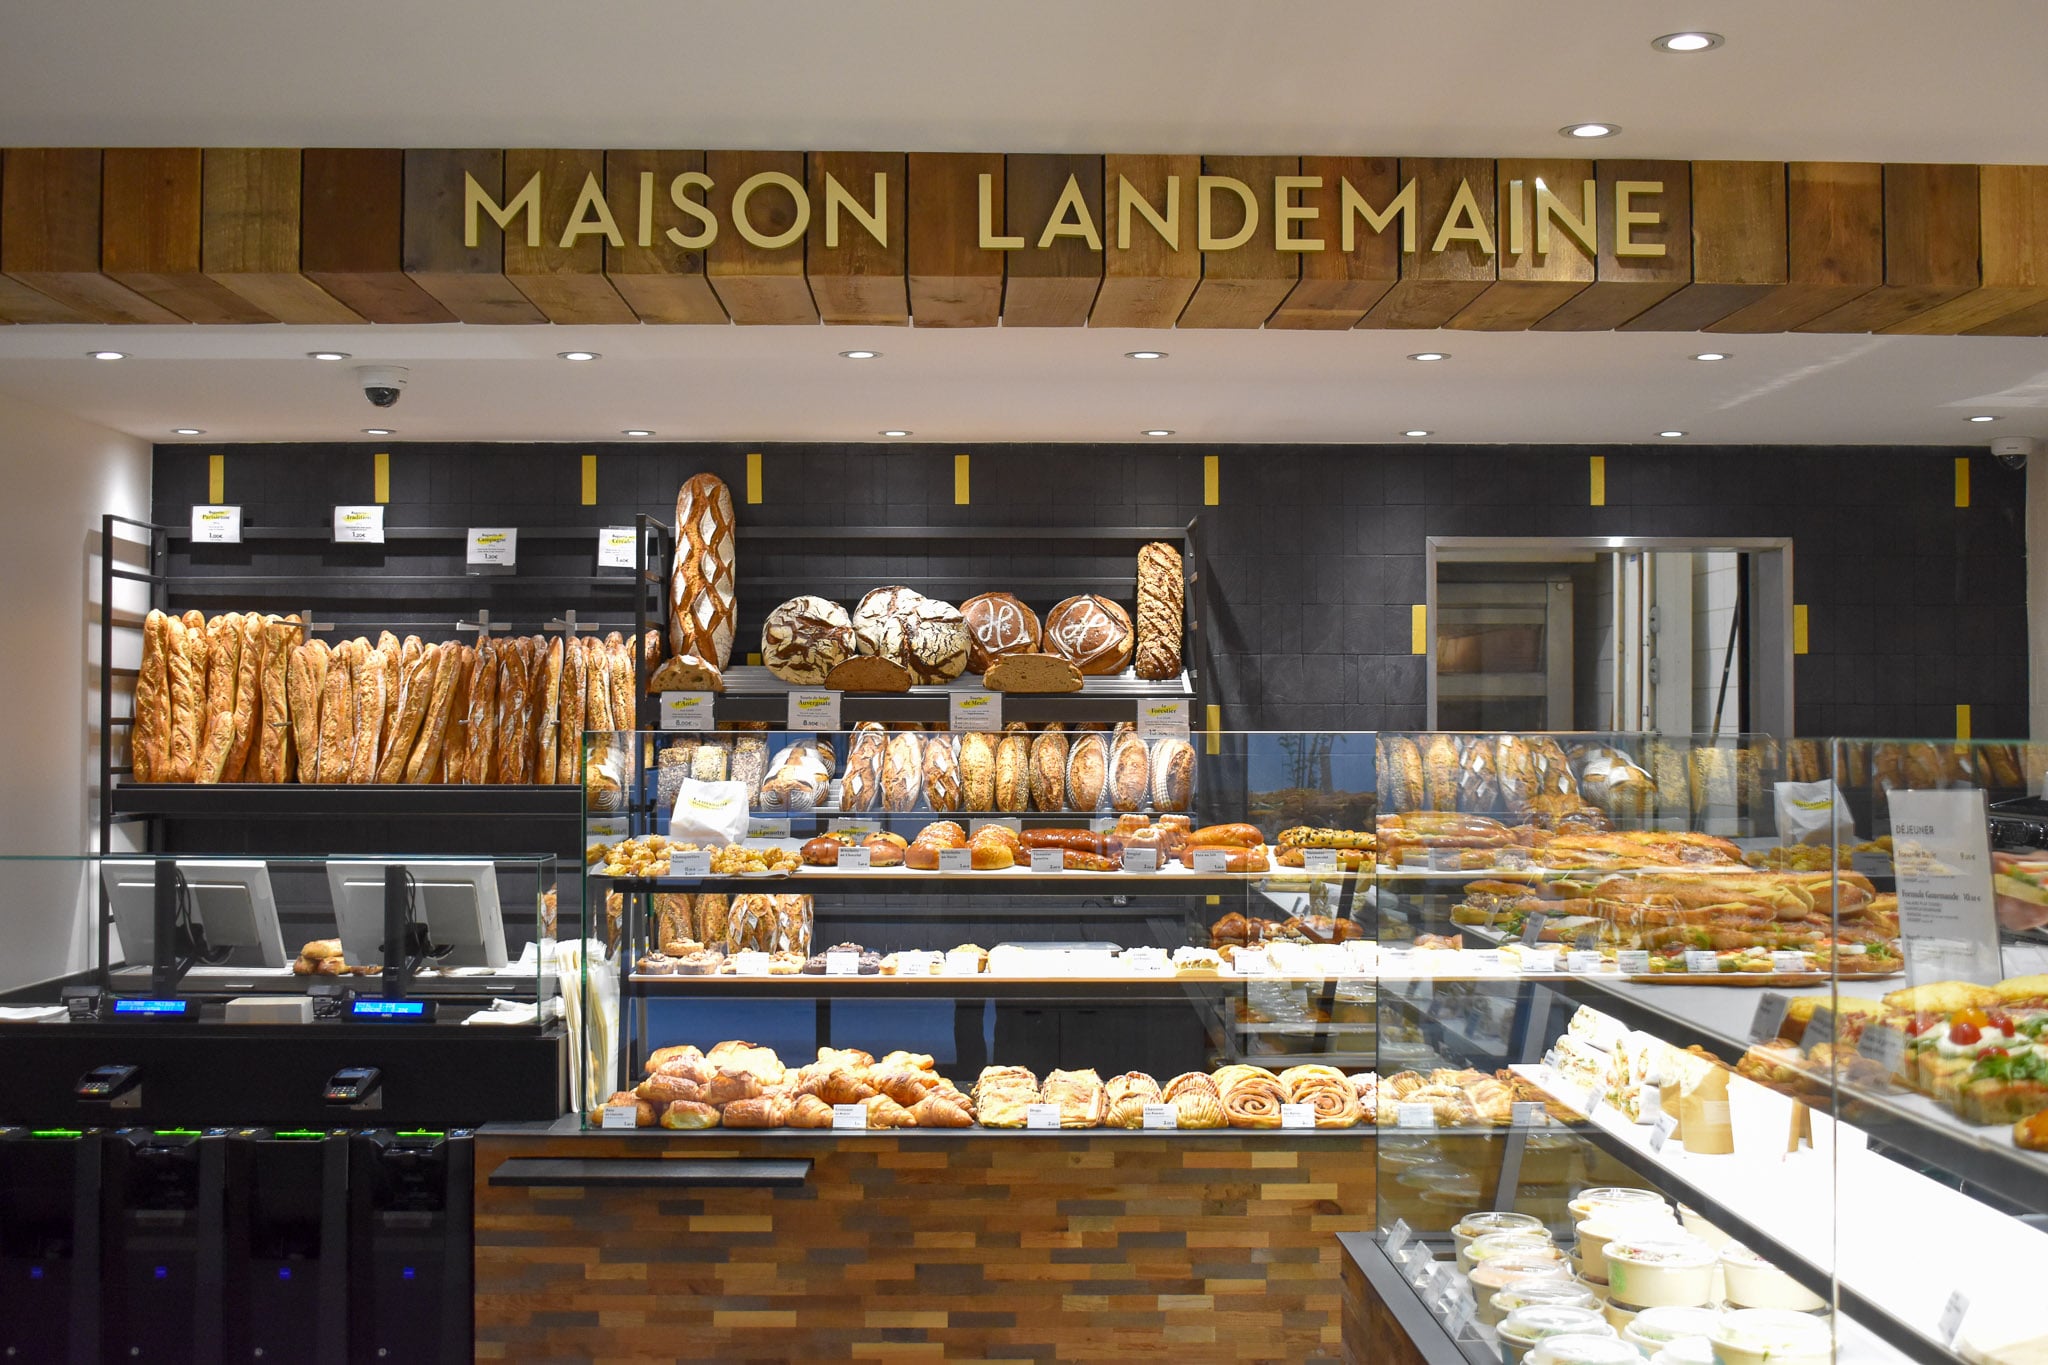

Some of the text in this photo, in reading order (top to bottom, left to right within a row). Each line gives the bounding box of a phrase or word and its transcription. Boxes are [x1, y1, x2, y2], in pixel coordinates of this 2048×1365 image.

[465, 170, 1666, 257] MAISON LANDEMAINE
[1895, 824, 1935, 836] DÉJEUNER
